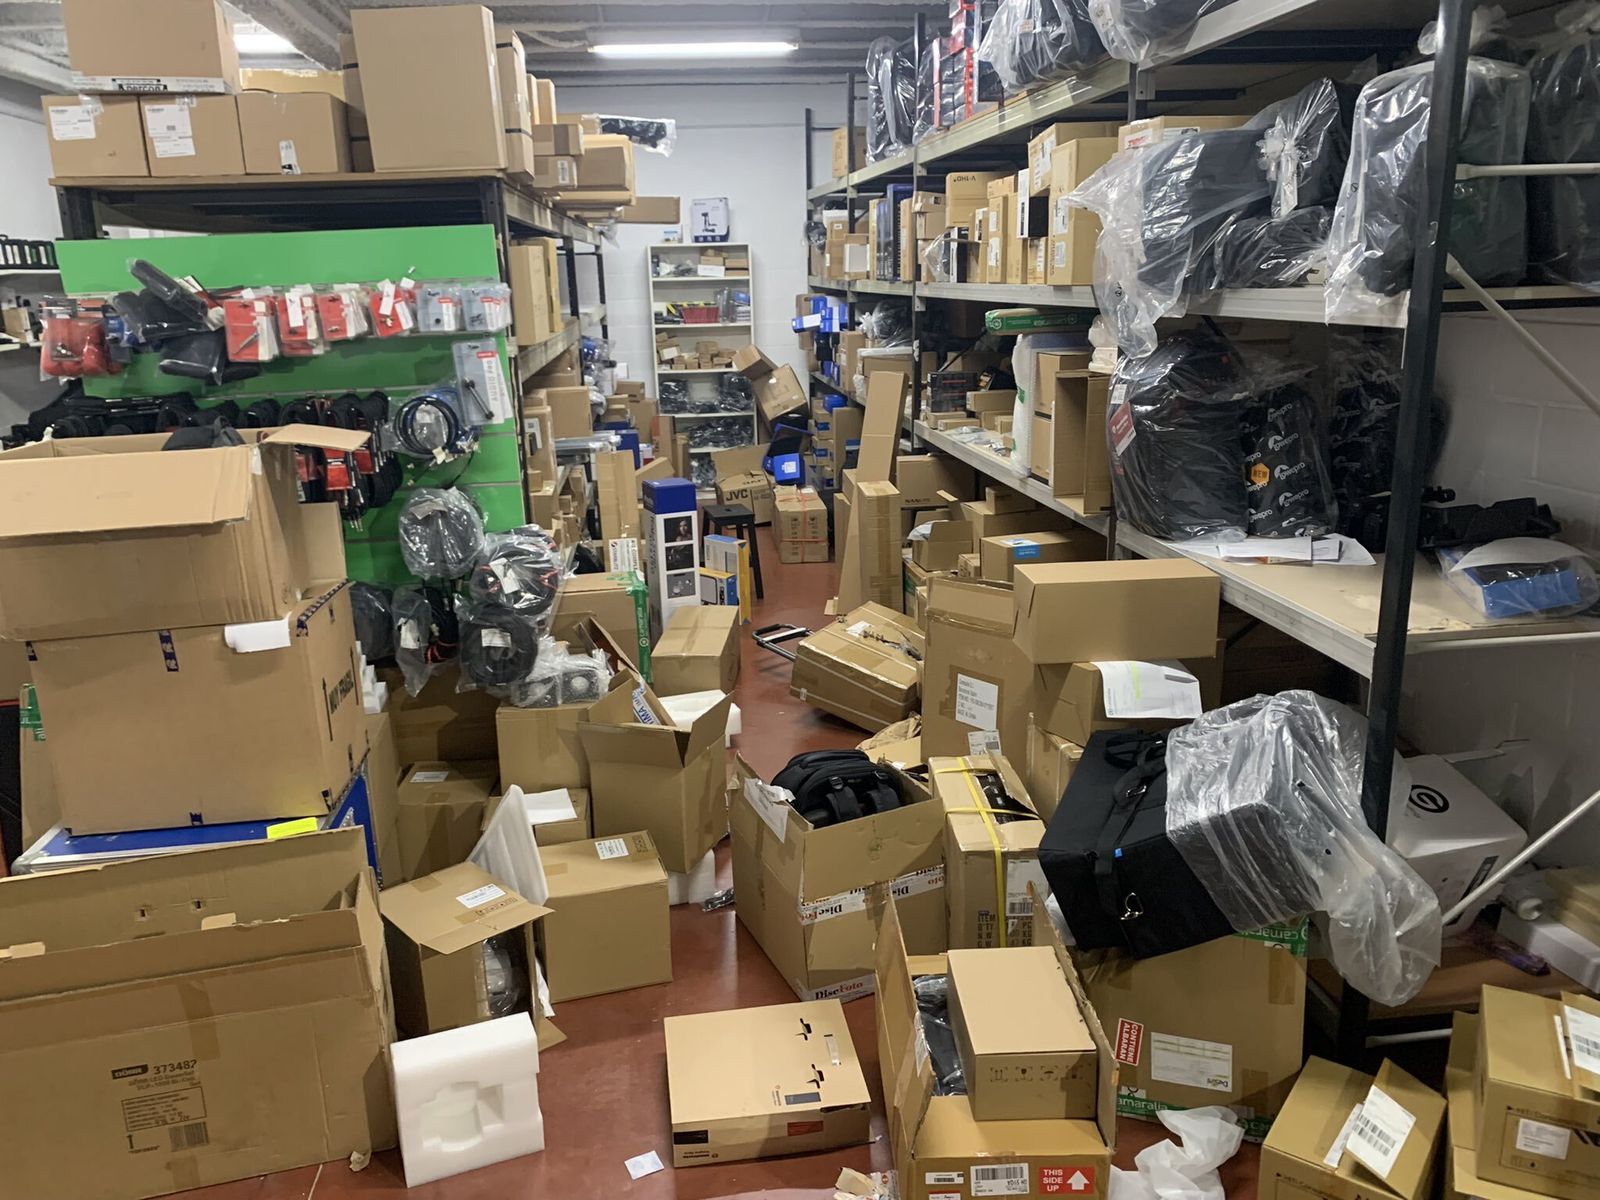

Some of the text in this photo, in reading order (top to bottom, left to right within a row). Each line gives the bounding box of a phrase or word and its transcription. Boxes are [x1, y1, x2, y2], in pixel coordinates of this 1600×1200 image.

[725, 488, 748, 502] JVC
[1120, 1022, 1131, 1060] ALBARAN
[1126, 1023, 1139, 1063] CONTIENE
[1043, 1177, 1063, 1185] SIDE
